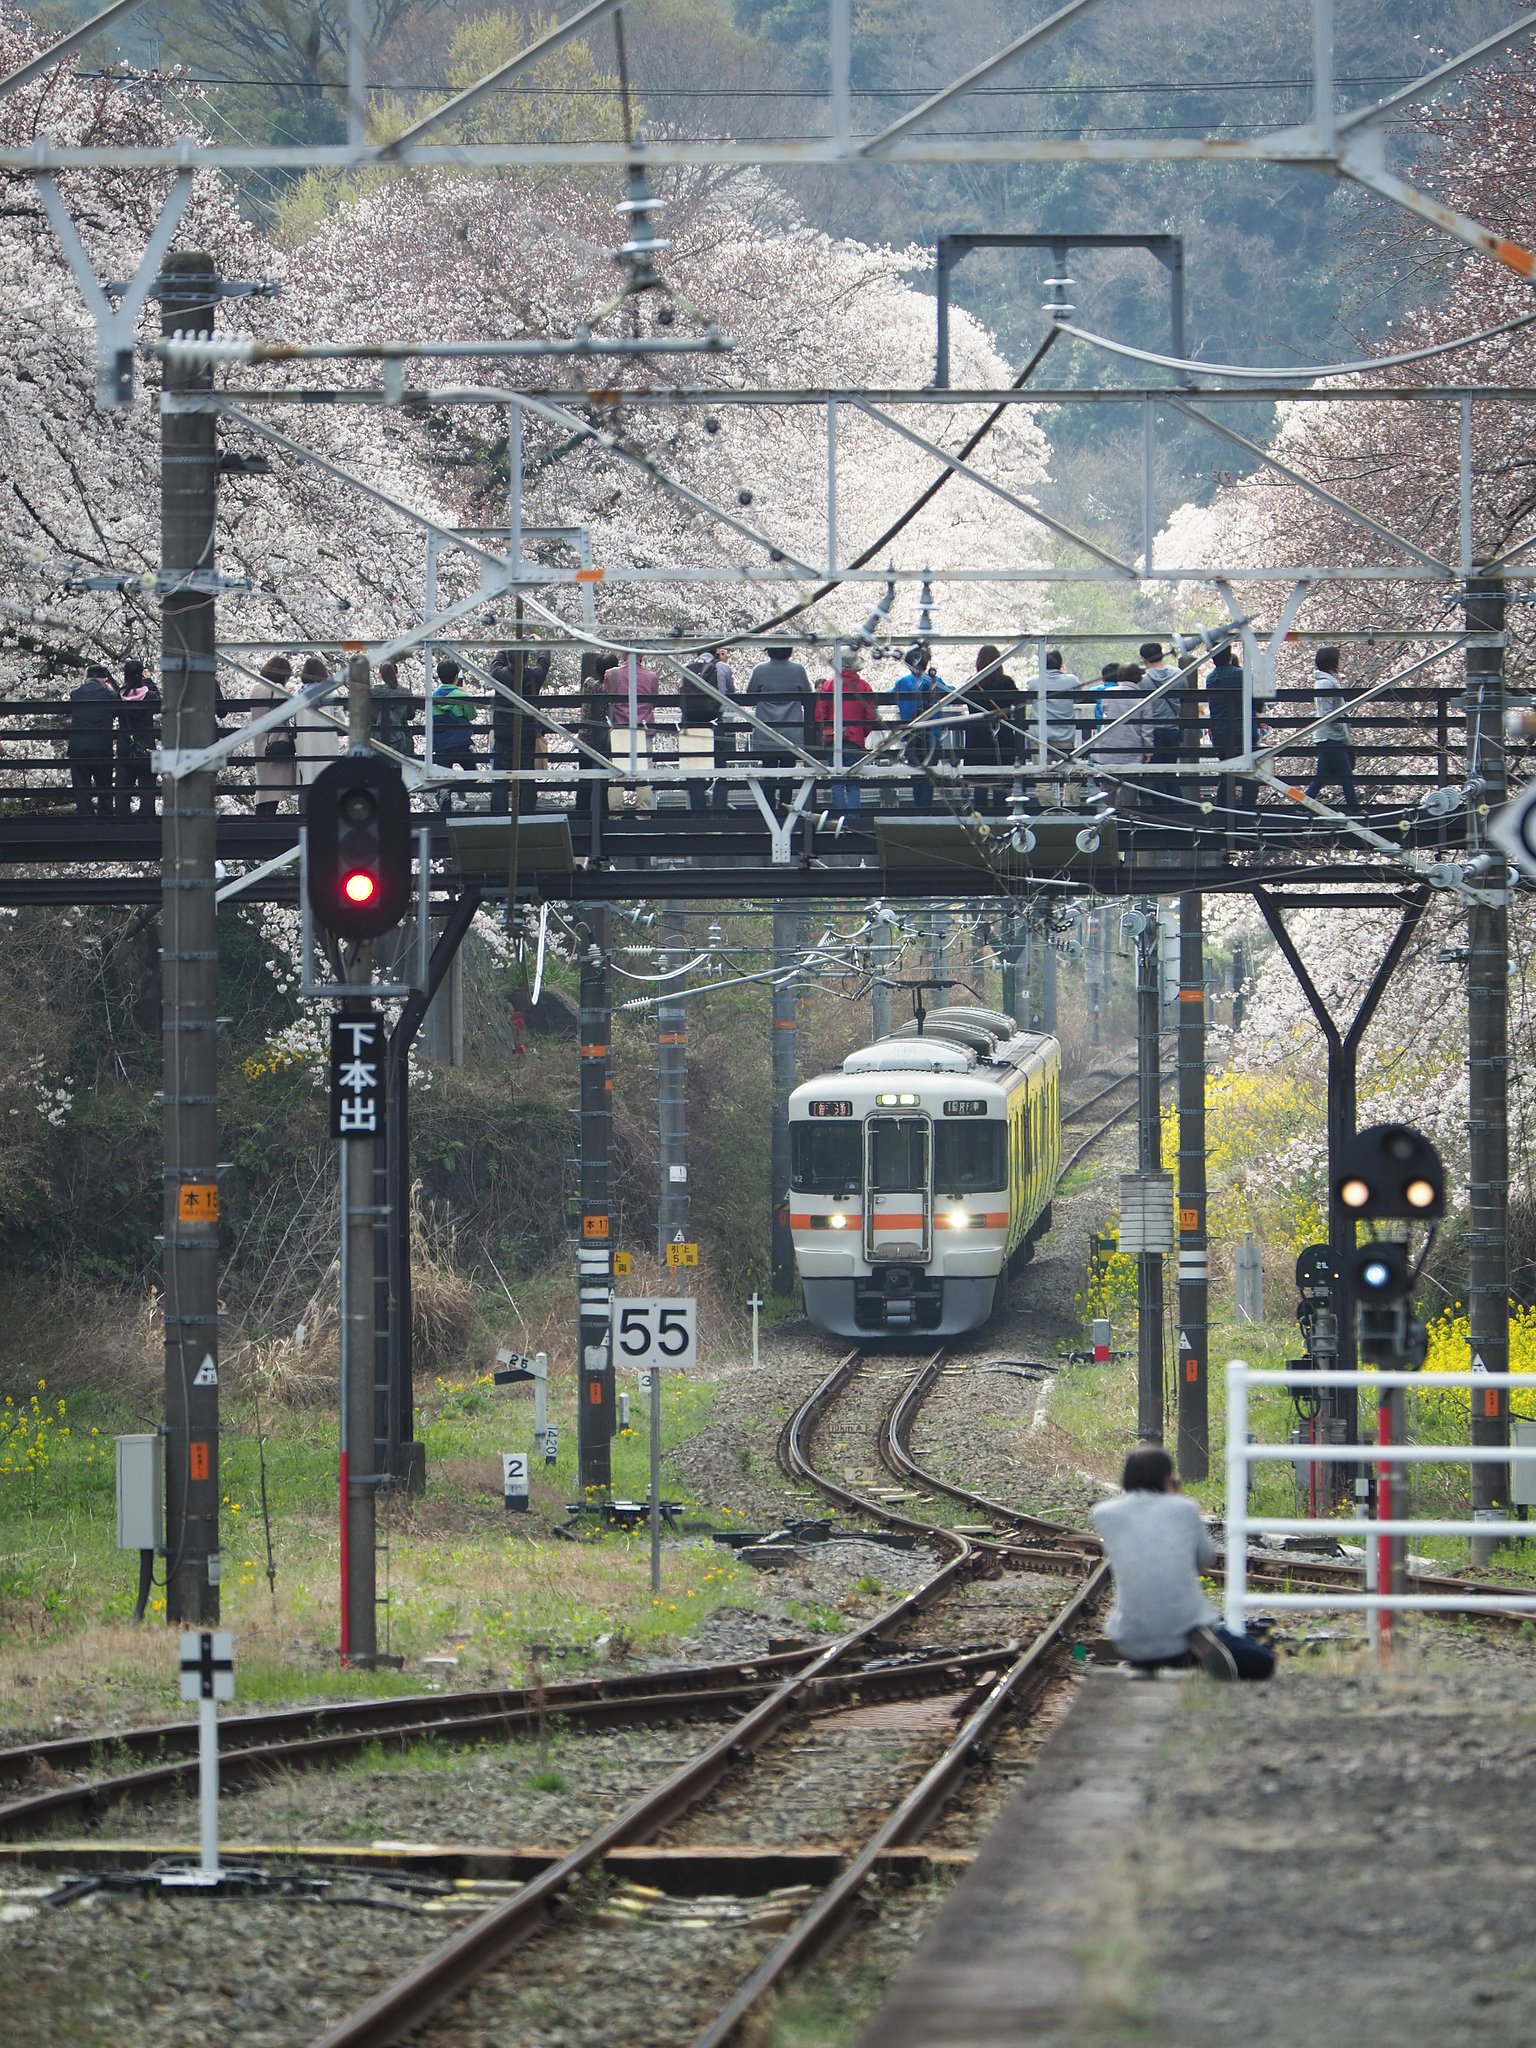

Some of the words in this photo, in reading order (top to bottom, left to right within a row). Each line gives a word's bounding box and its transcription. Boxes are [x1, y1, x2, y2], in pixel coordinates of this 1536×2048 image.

[338, 1022, 378, 1131] 下本出
[183, 1191, 200, 1208] 本
[585, 1219, 596, 1230] 本
[1184, 1212, 1196, 1222] 17
[619, 1308, 690, 1357] 55
[509, 1354, 529, 1369] 25
[641, 1375, 652, 1387] 3
[546, 1427, 558, 1454] 1420
[508, 1460, 524, 1478] 2
[854, 1469, 864, 1480] 2
